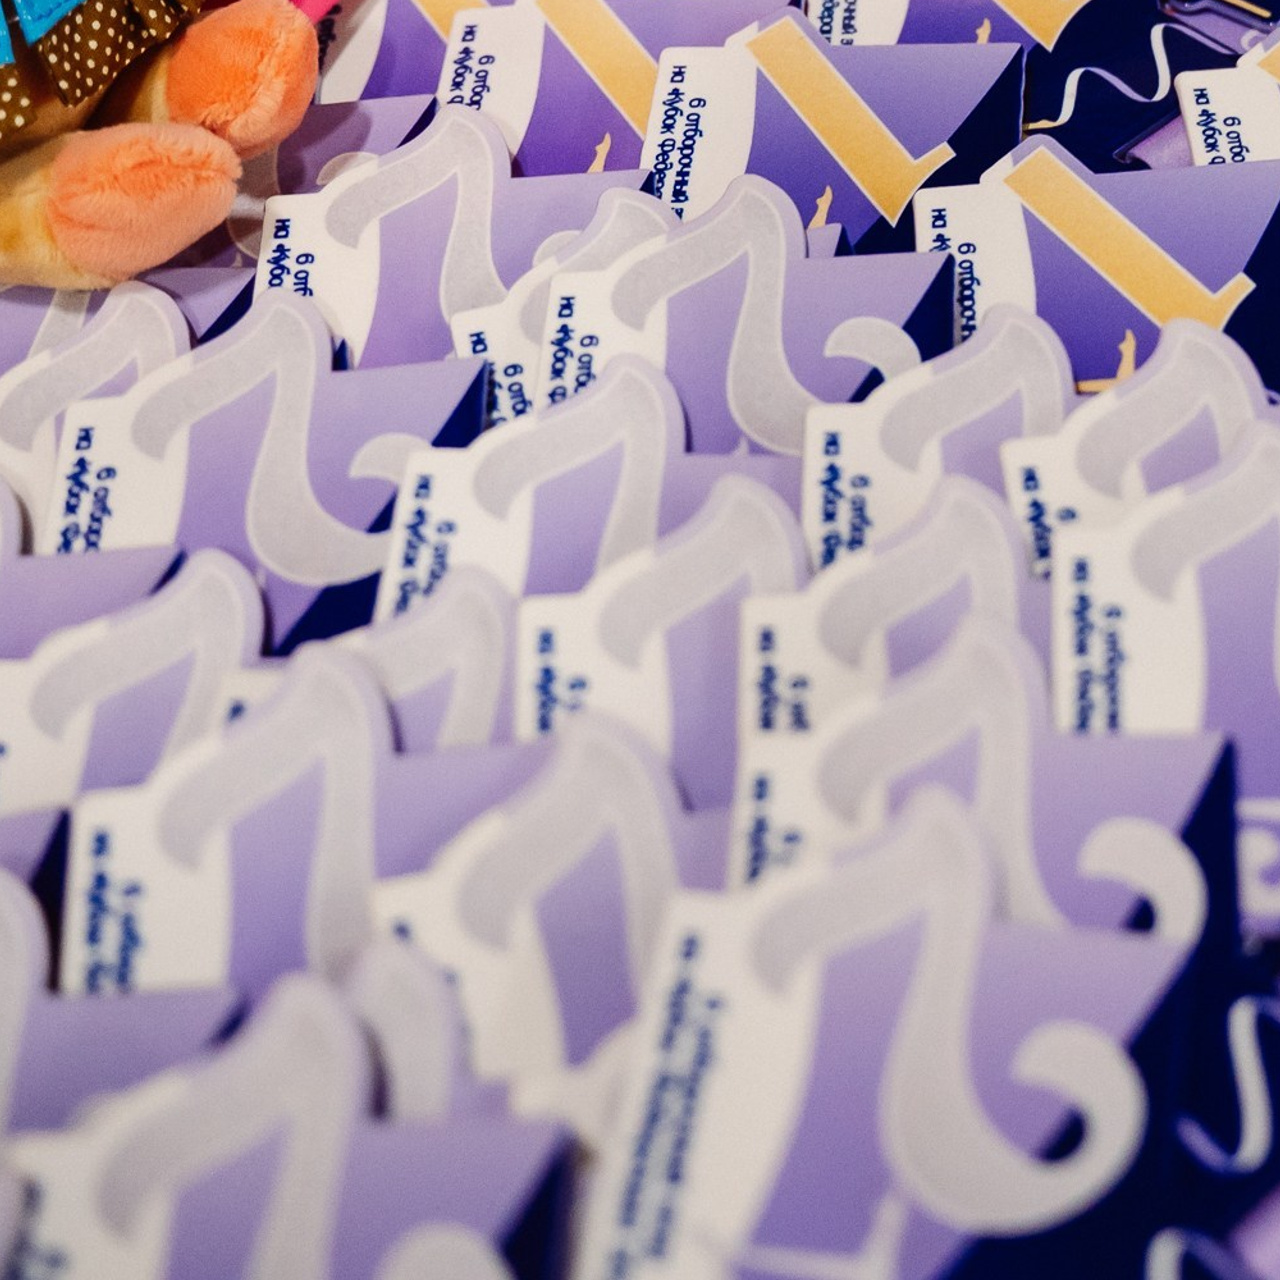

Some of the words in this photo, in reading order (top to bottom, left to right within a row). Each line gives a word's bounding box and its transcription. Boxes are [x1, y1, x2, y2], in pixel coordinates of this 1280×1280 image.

[462, 24, 478, 43] на
[478, 54, 496, 66] 6
[670, 65, 687, 84] на
[688, 97, 707, 109] 6
[1193, 87, 1210, 105] на
[661, 88, 686, 135] «Кубок
[1196, 109, 1222, 153] «Кубок
[1222, 116, 1241, 127] 6
[670, 112, 704, 204] отборочный
[931, 208, 948, 229] на
[273, 218, 291, 239] на
[957, 242, 977, 255] 6
[295, 252, 315, 265] 6
[558, 296, 576, 319] на
[469, 330, 489, 355] на
[579, 334, 600, 348] 6
[504, 363, 524, 378] 6
[75, 426, 95, 451] на
[96, 467, 117, 480] 6
